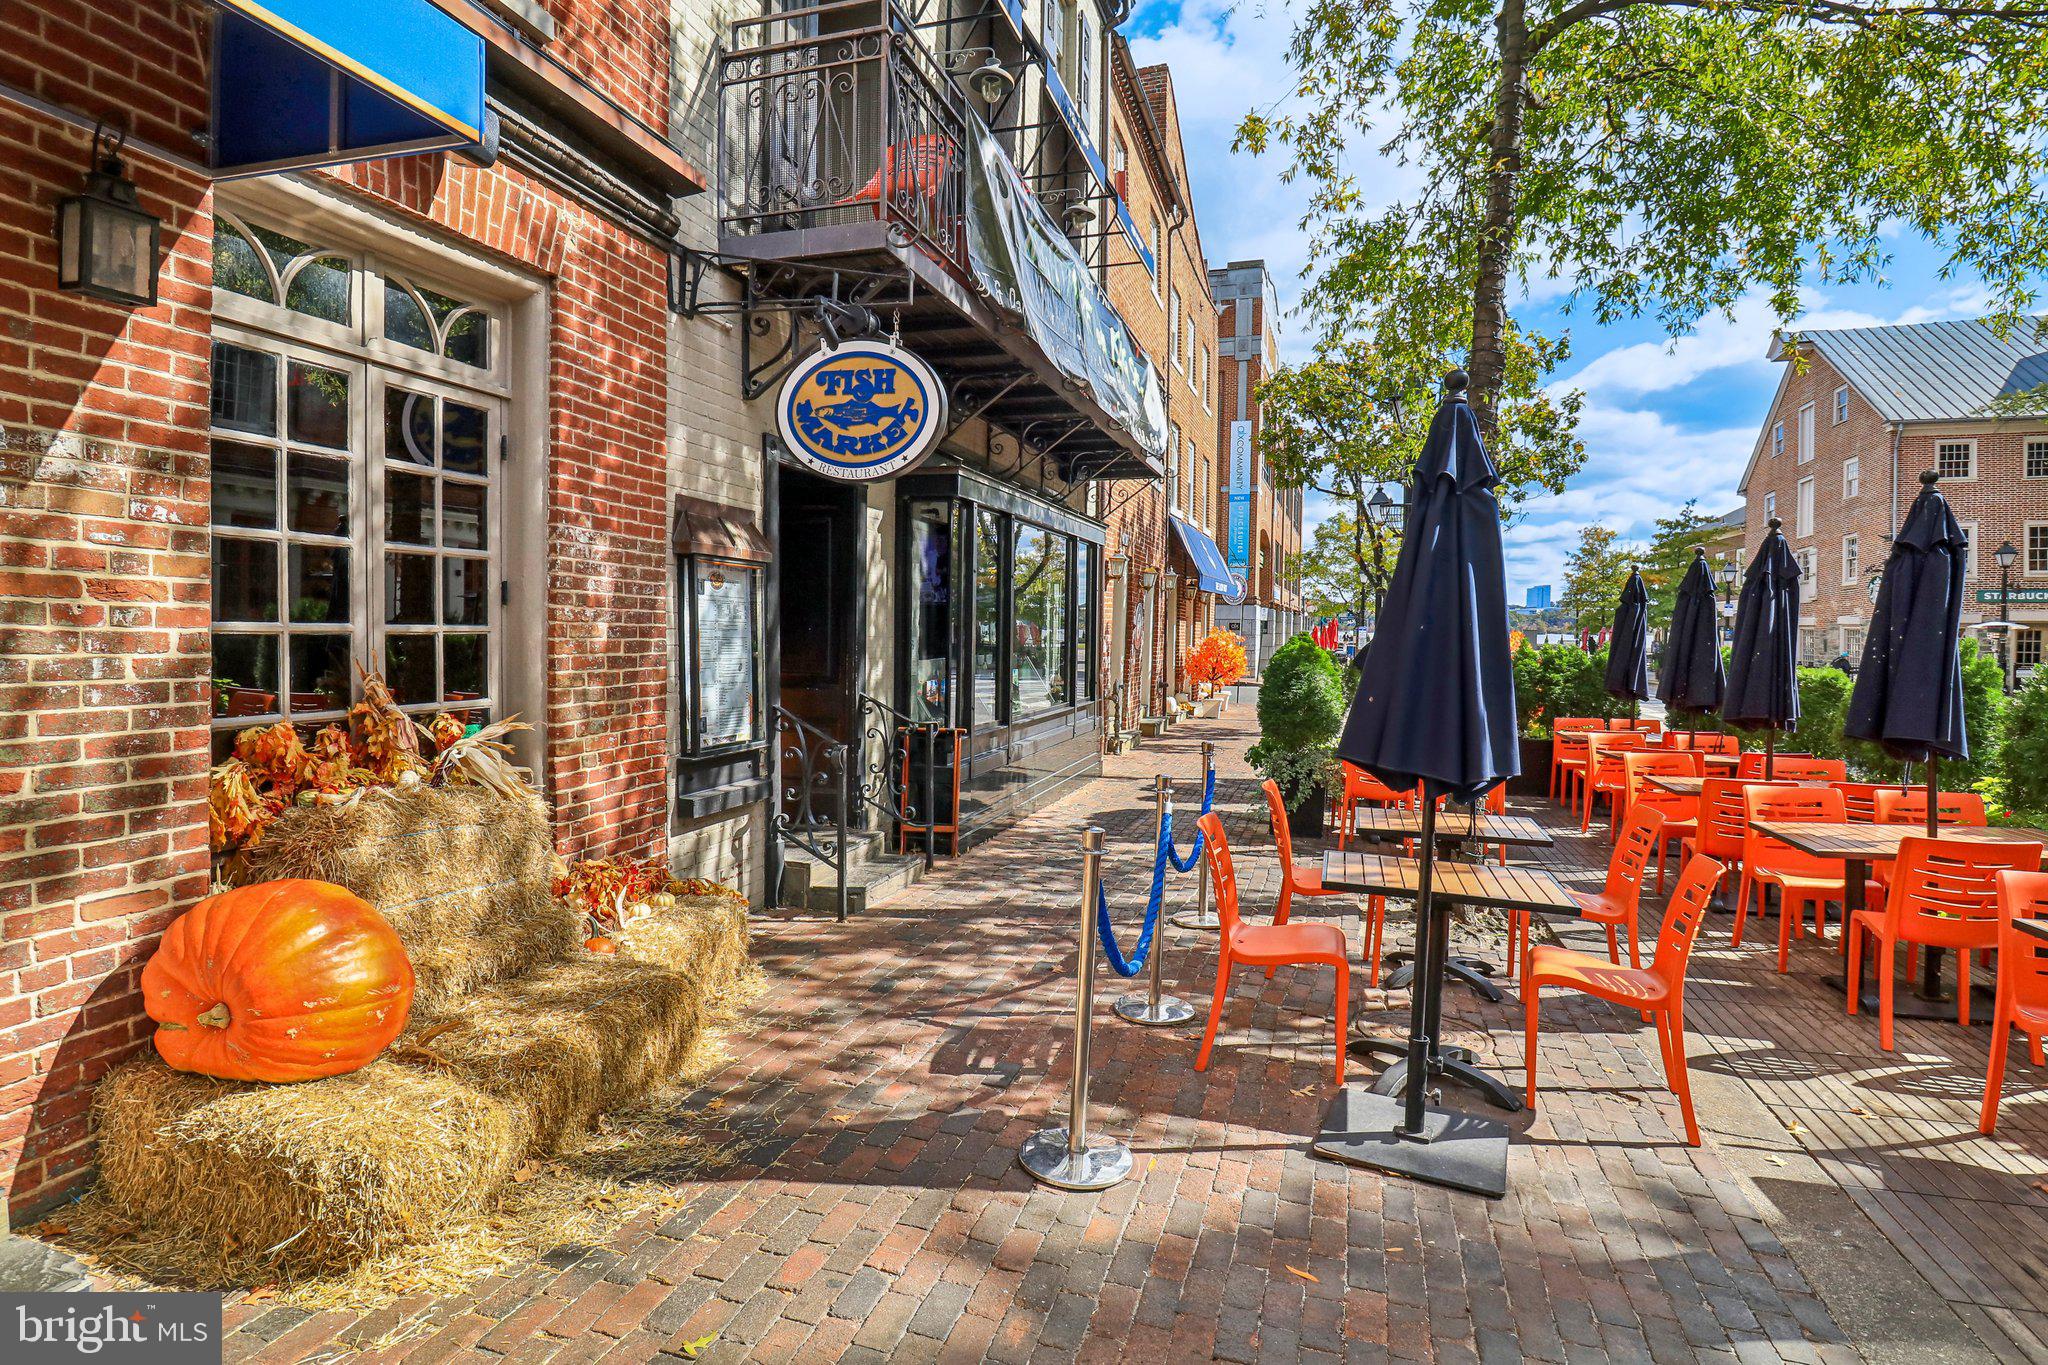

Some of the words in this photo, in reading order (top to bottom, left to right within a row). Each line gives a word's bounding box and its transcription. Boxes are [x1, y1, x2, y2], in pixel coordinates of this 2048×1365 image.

[815, 368, 897, 402] FISH
[796, 397, 919, 455] MARKET
[818, 459, 898, 479] RESTAURANT
